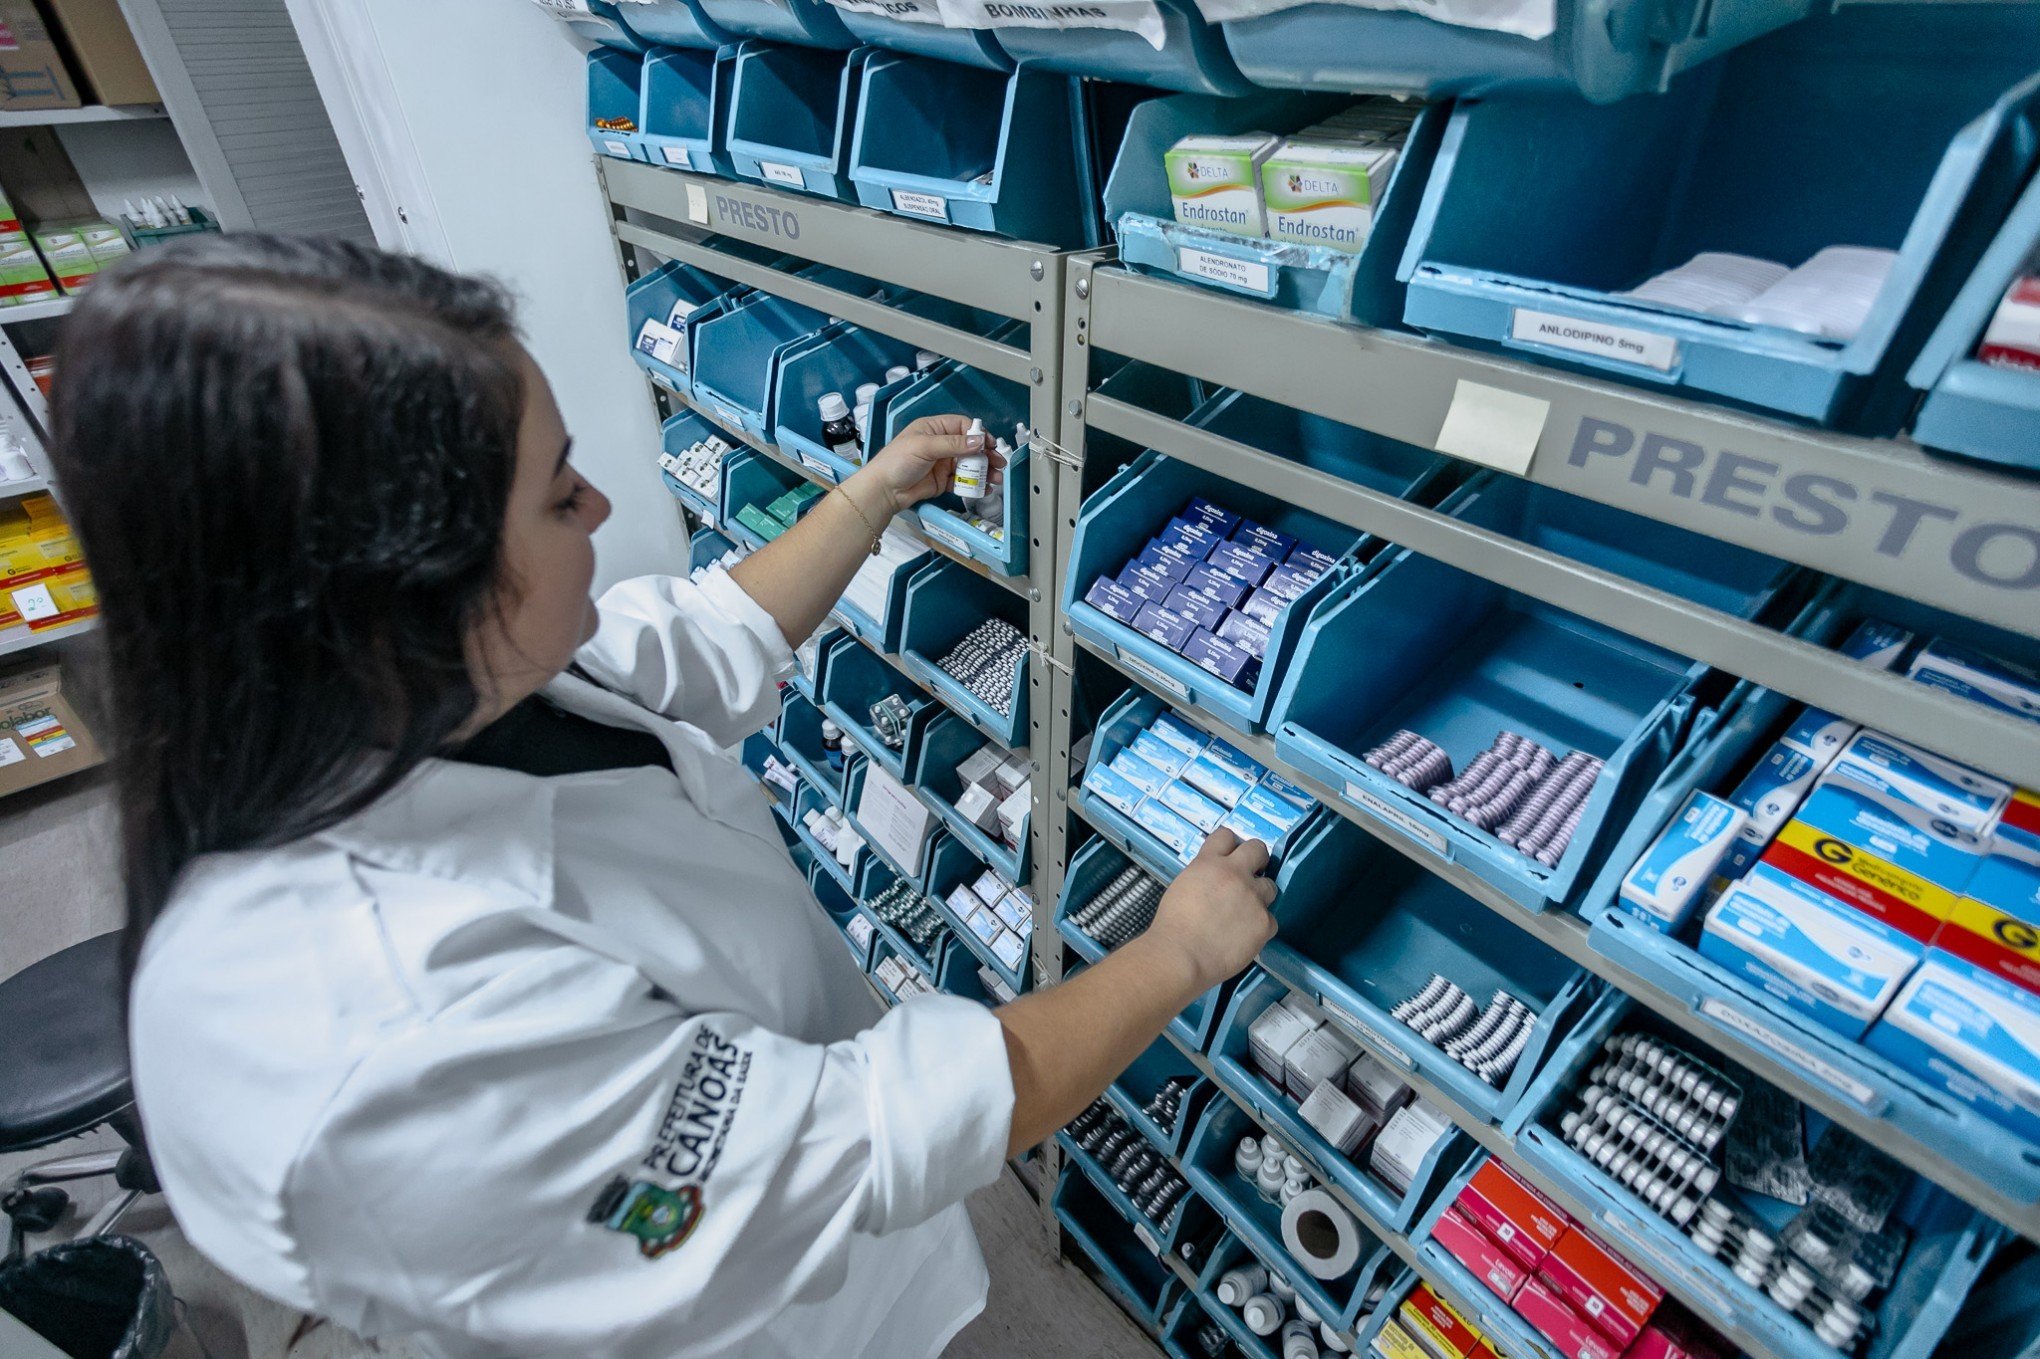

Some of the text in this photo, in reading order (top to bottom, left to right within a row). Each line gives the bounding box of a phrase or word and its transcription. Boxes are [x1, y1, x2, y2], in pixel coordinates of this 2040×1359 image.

[1200, 166, 1229, 178] DELTA
[1304, 179, 1338, 193] DELTA
[716, 195, 800, 240] PRESTO
[1183, 202, 1246, 224] Endrostan
[1278, 216, 1355, 244] Endrostan
[1200, 256, 1246, 272] ALENDRONATO
[1200, 265, 1208, 273] DE
[1238, 276, 1248, 284] mg
[1539, 323, 1645, 354] ANLODIPINO 5mg
[1568, 416, 2040, 591] PRESTO
[1256, 526, 1278, 540] digoxina
[1311, 550, 1335, 564] digoxina
[1362, 794, 1405, 823] ENALAPRIL
[644, 1024, 716, 1170] PREFEITURA DE
[667, 1032, 737, 1176] CANOAS
